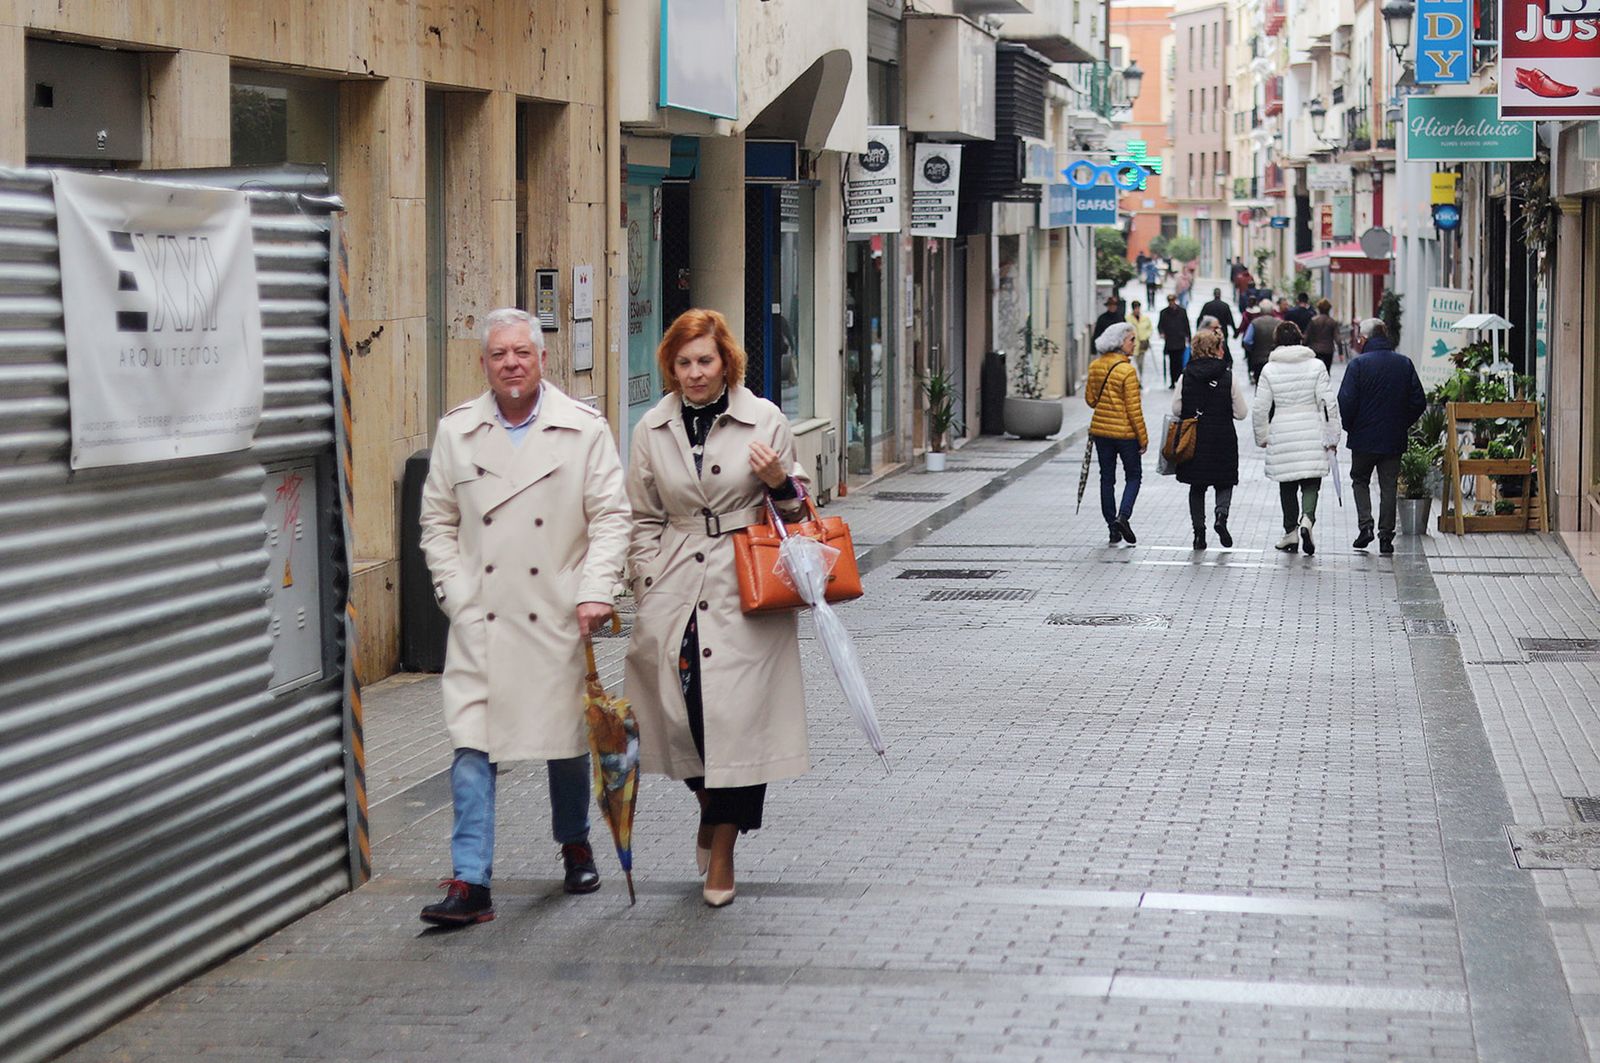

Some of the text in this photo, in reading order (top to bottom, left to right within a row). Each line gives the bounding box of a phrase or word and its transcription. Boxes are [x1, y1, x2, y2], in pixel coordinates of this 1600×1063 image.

[1424, 0, 1463, 77] DY
[1411, 116, 1521, 137] Hierbaluisa
[850, 179, 894, 187] MANUALIDADES
[1077, 199, 1115, 211] GAFAS
[1432, 297, 1465, 312] Little
[119, 347, 220, 367] ARQUITECTOS
